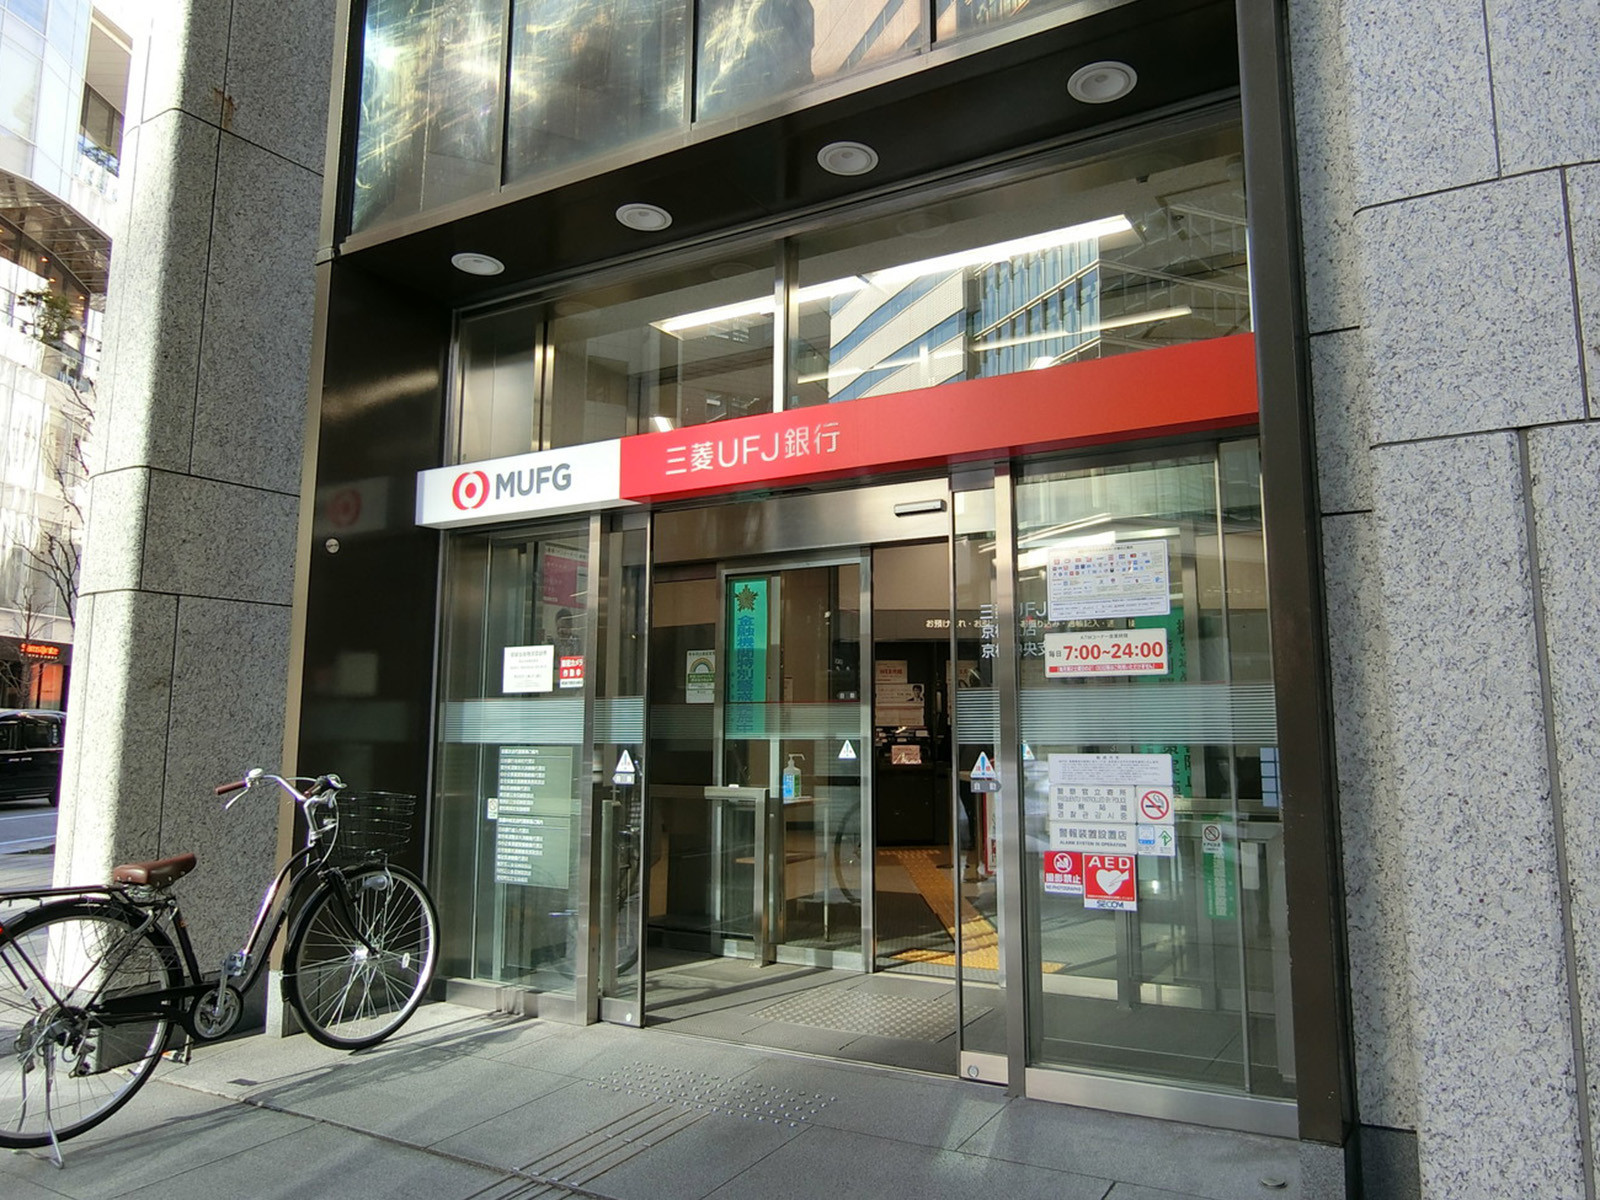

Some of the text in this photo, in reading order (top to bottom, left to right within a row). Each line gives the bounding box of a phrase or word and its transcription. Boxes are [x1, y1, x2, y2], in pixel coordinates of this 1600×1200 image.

[666, 422, 840, 475] 三菱UFJ銀行
[496, 463, 571, 500] MUFG
[1049, 650, 1062, 658] 毎日
[1088, 856, 1131, 868] AED
[1097, 900, 1124, 908] SECOM
